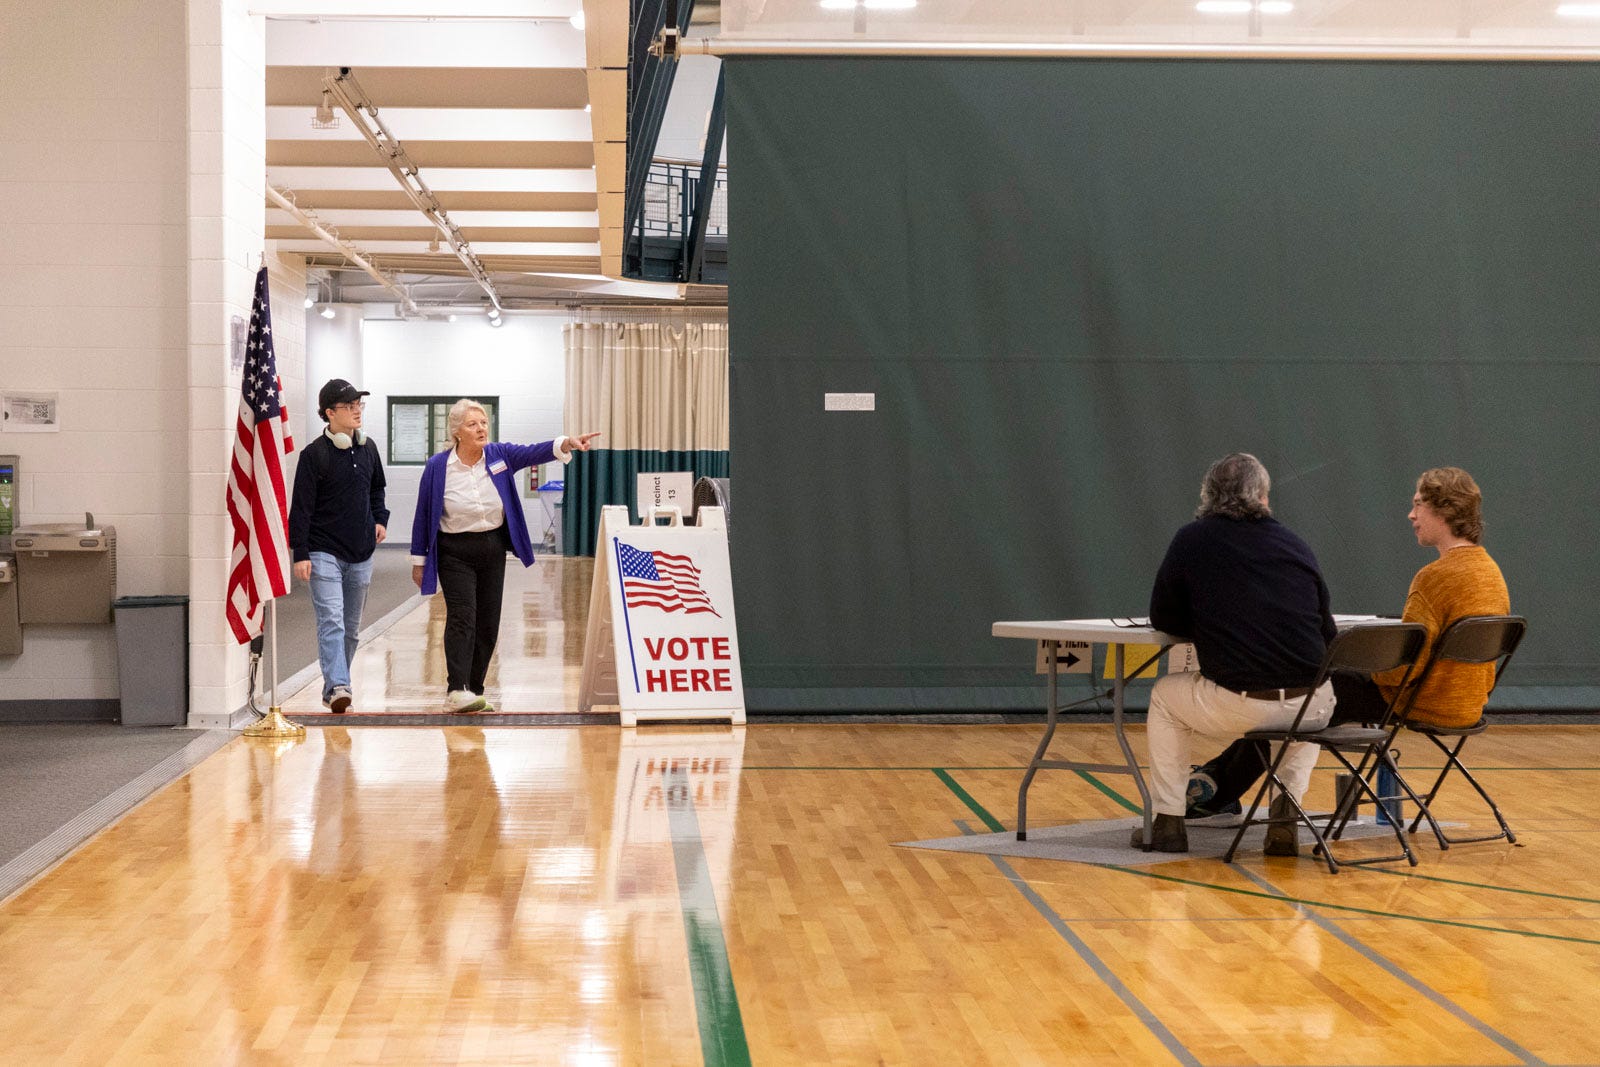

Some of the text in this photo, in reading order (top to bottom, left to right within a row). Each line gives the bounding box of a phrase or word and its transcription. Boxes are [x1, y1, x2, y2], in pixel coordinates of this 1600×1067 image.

[653, 476, 661, 507] recinct
[668, 489, 676, 500] 13
[643, 637, 731, 661] VOTE
[646, 669, 733, 692] HERE
